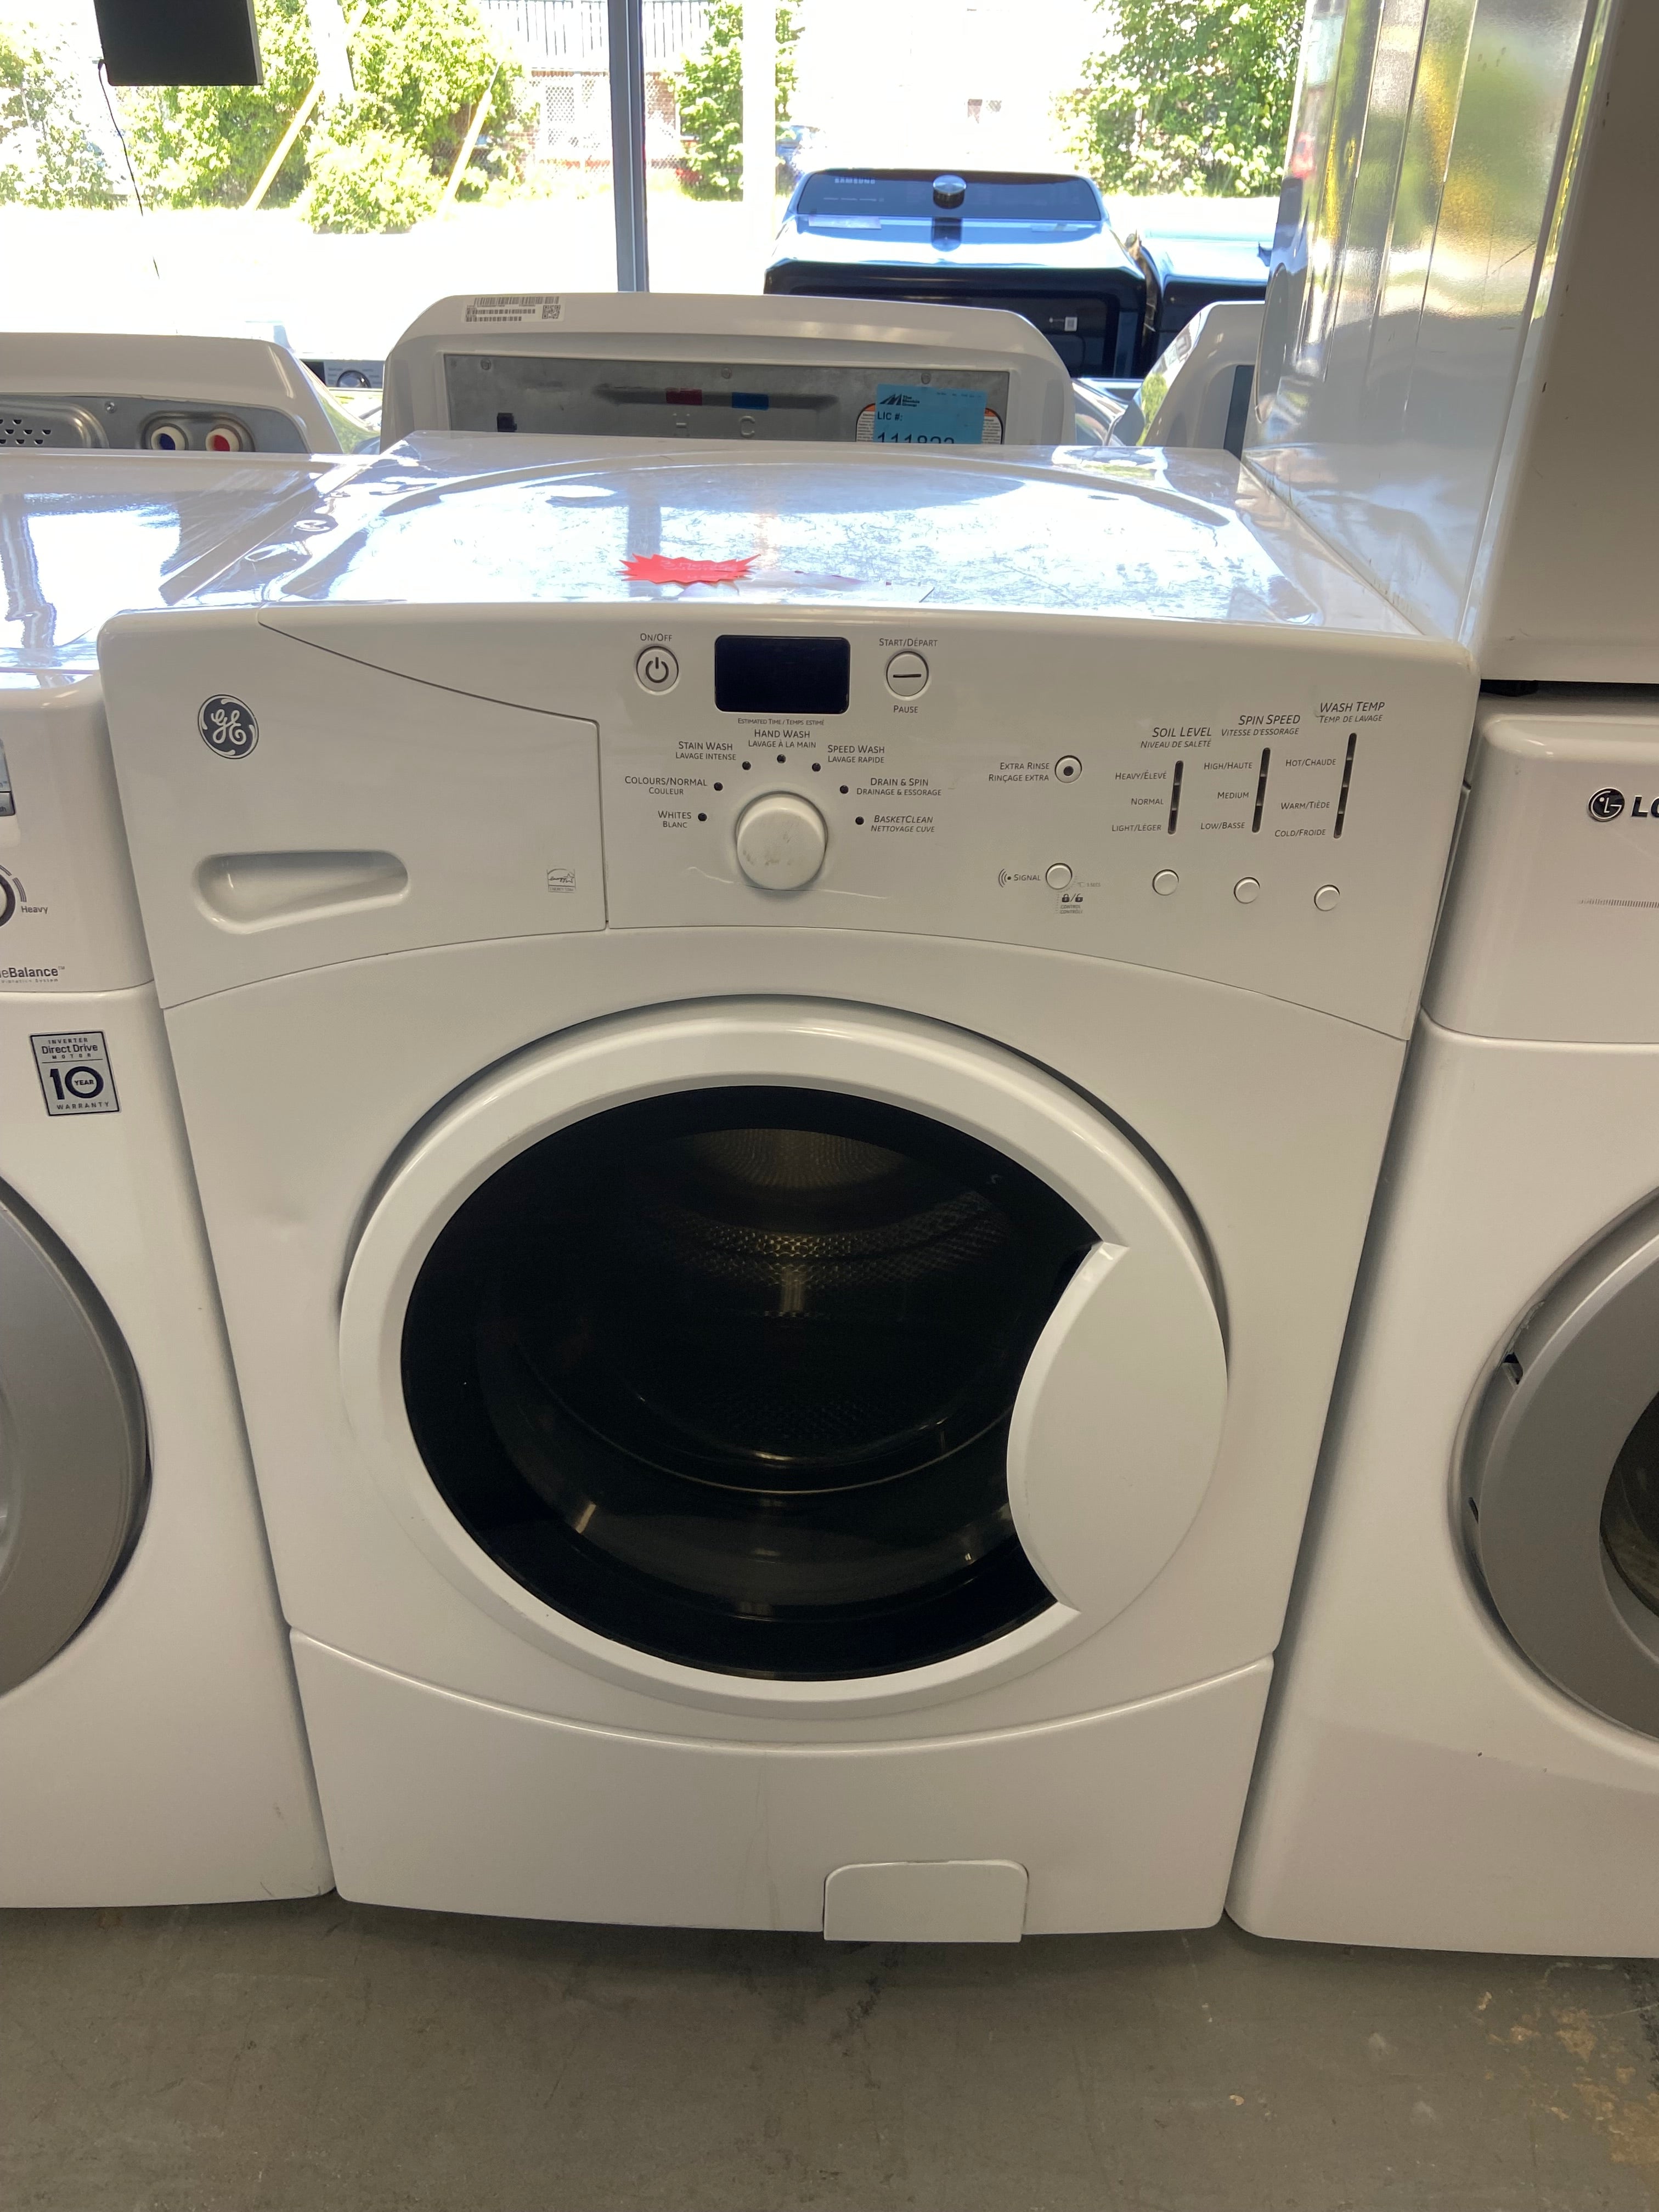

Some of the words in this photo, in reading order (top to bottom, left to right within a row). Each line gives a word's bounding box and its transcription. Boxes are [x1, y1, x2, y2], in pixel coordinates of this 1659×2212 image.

[878, 411, 892, 420] LIC
[640, 633, 673, 641] ON/OFF
[893, 705, 918, 713] PAUSE
[1320, 702, 1353, 713] WASH
[1356, 701, 1385, 712] TEMP
[1238, 715, 1264, 725] SPIN
[1266, 714, 1301, 725] SPEED
[1355, 714, 1384, 723] LAVAGE
[754, 729, 781, 738] HAND
[783, 730, 810, 738] WASH
[1152, 727, 1176, 737] SOIL
[1180, 726, 1212, 737] LEVEL
[1253, 727, 1300, 736] D'ESSORAGE
[678, 741, 704, 750] STAIN
[706, 742, 733, 751] WASH
[748, 740, 776, 748] LAVAGE
[778, 739, 783, 748] À
[827, 744, 855, 753] SPEED
[857, 745, 885, 754] WASH
[675, 752, 704, 760] LAVAGE
[706, 753, 737, 761] INTENSE
[1000, 762, 1025, 770] EXTRA
[1027, 761, 1050, 770] RINSE
[1204, 761, 1253, 770] HIGH/HAUTE
[1285, 758, 1337, 767] HOT/CHAUDE
[624, 776, 708, 787] COLOURS/NORMAL
[870, 777, 898, 786] DRAIN
[909, 778, 929, 786] SPIN
[988, 774, 1023, 783] RINÇAGE
[649, 787, 684, 795] COULEUR
[658, 810, 692, 819] WHITES
[1274, 829, 1327, 837] COLD/FROIDE
[21, 905, 48, 915] Heavy
[41, 1046, 72, 1054] Direct
[72, 1043, 98, 1053] Drive
[50, 1066, 104, 1100] 10
[57, 1101, 110, 1110] WARRANTY
